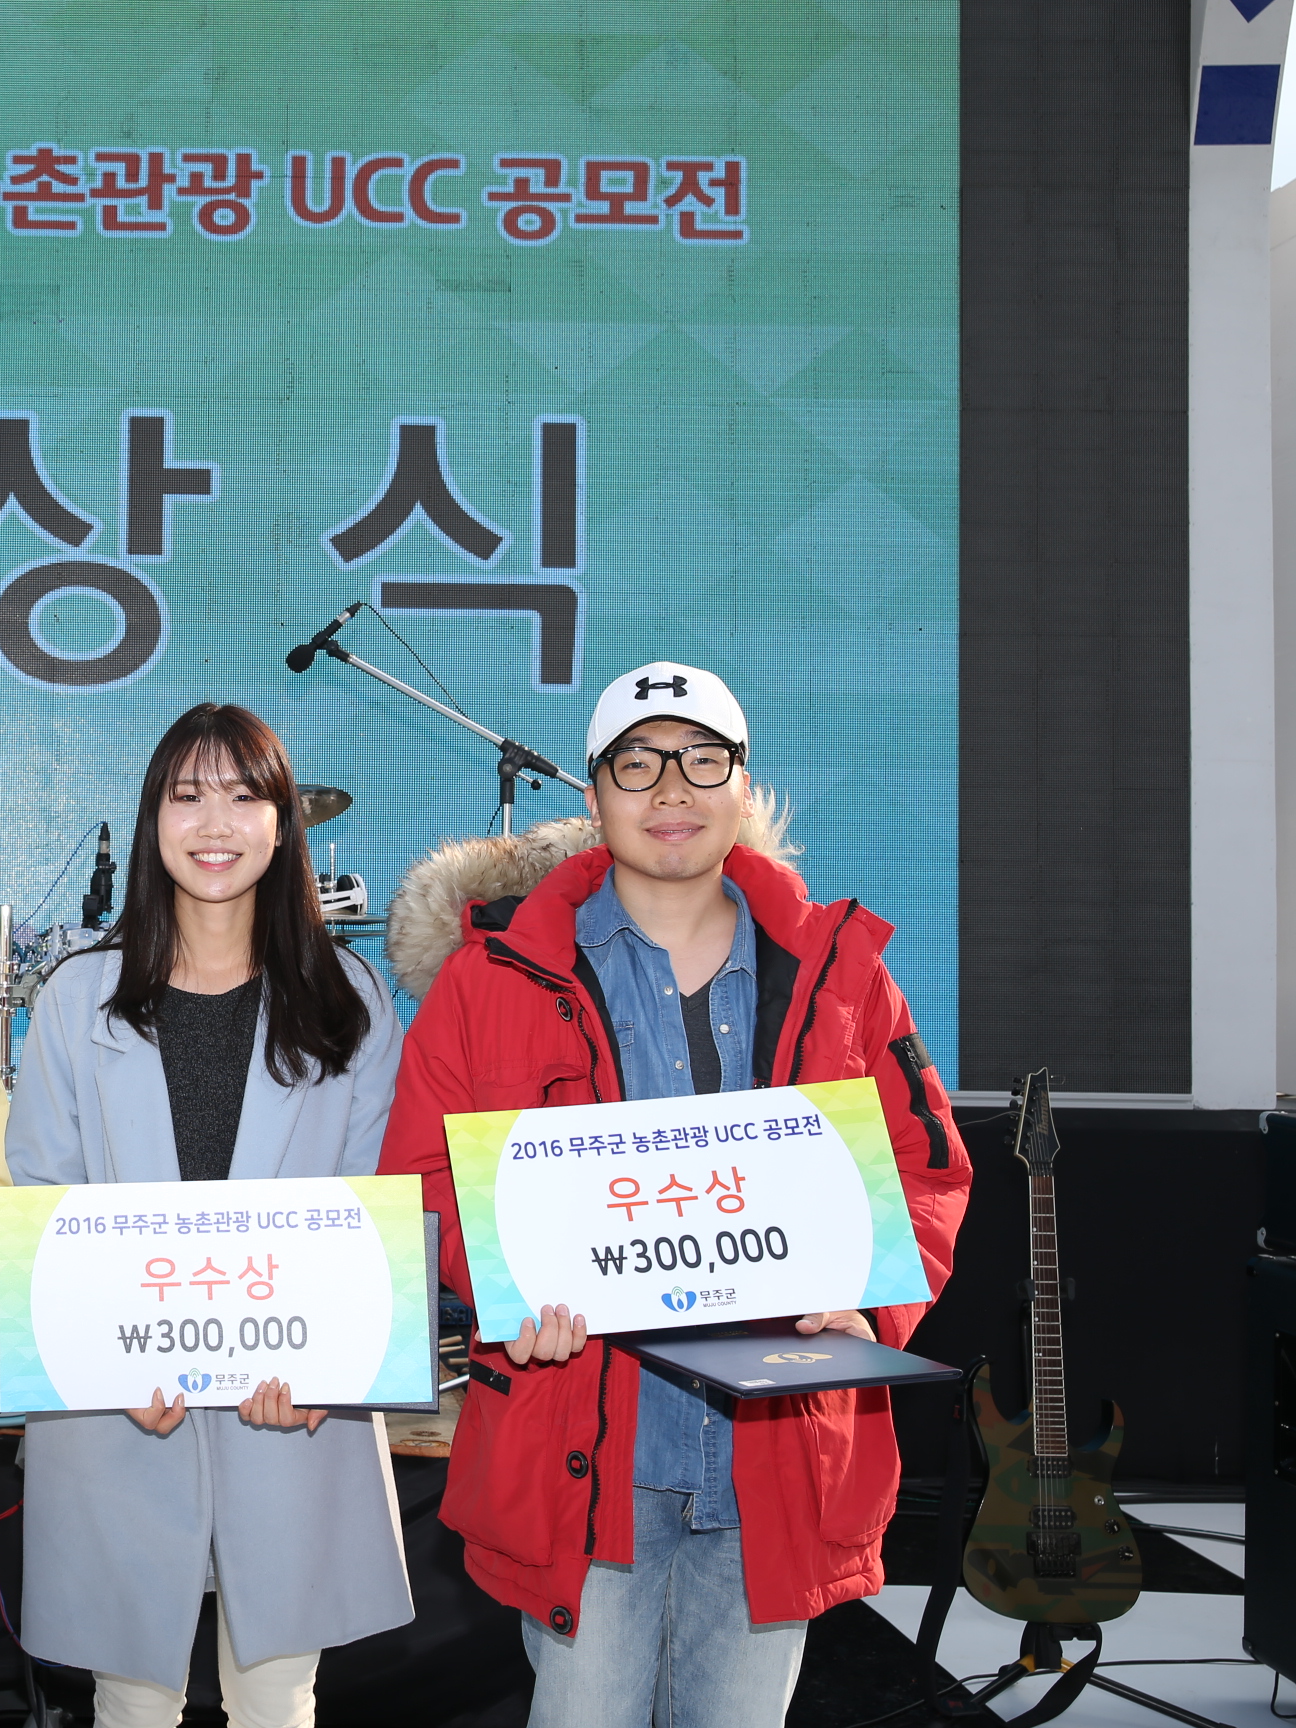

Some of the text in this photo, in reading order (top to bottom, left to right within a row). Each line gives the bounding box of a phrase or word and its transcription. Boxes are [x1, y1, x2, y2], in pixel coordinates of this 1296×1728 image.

[289, 154, 463, 225] UCC
[486, 156, 745, 242] 공모전
[510, 1114, 823, 1161] 2016 무주군 농촌관광 UCC 공모전
[606, 1165, 747, 1222] 우수상
[55, 1206, 362, 1236] 2016 무주군 농촌관광 UCC 공모전
[591, 1225, 789, 1277] ₩300,000
[140, 1253, 280, 1302] 우수상
[699, 1287, 737, 1302] 무주군
[117, 1315, 308, 1358] ₩300,000
[215, 1373, 250, 1385] 무주군
